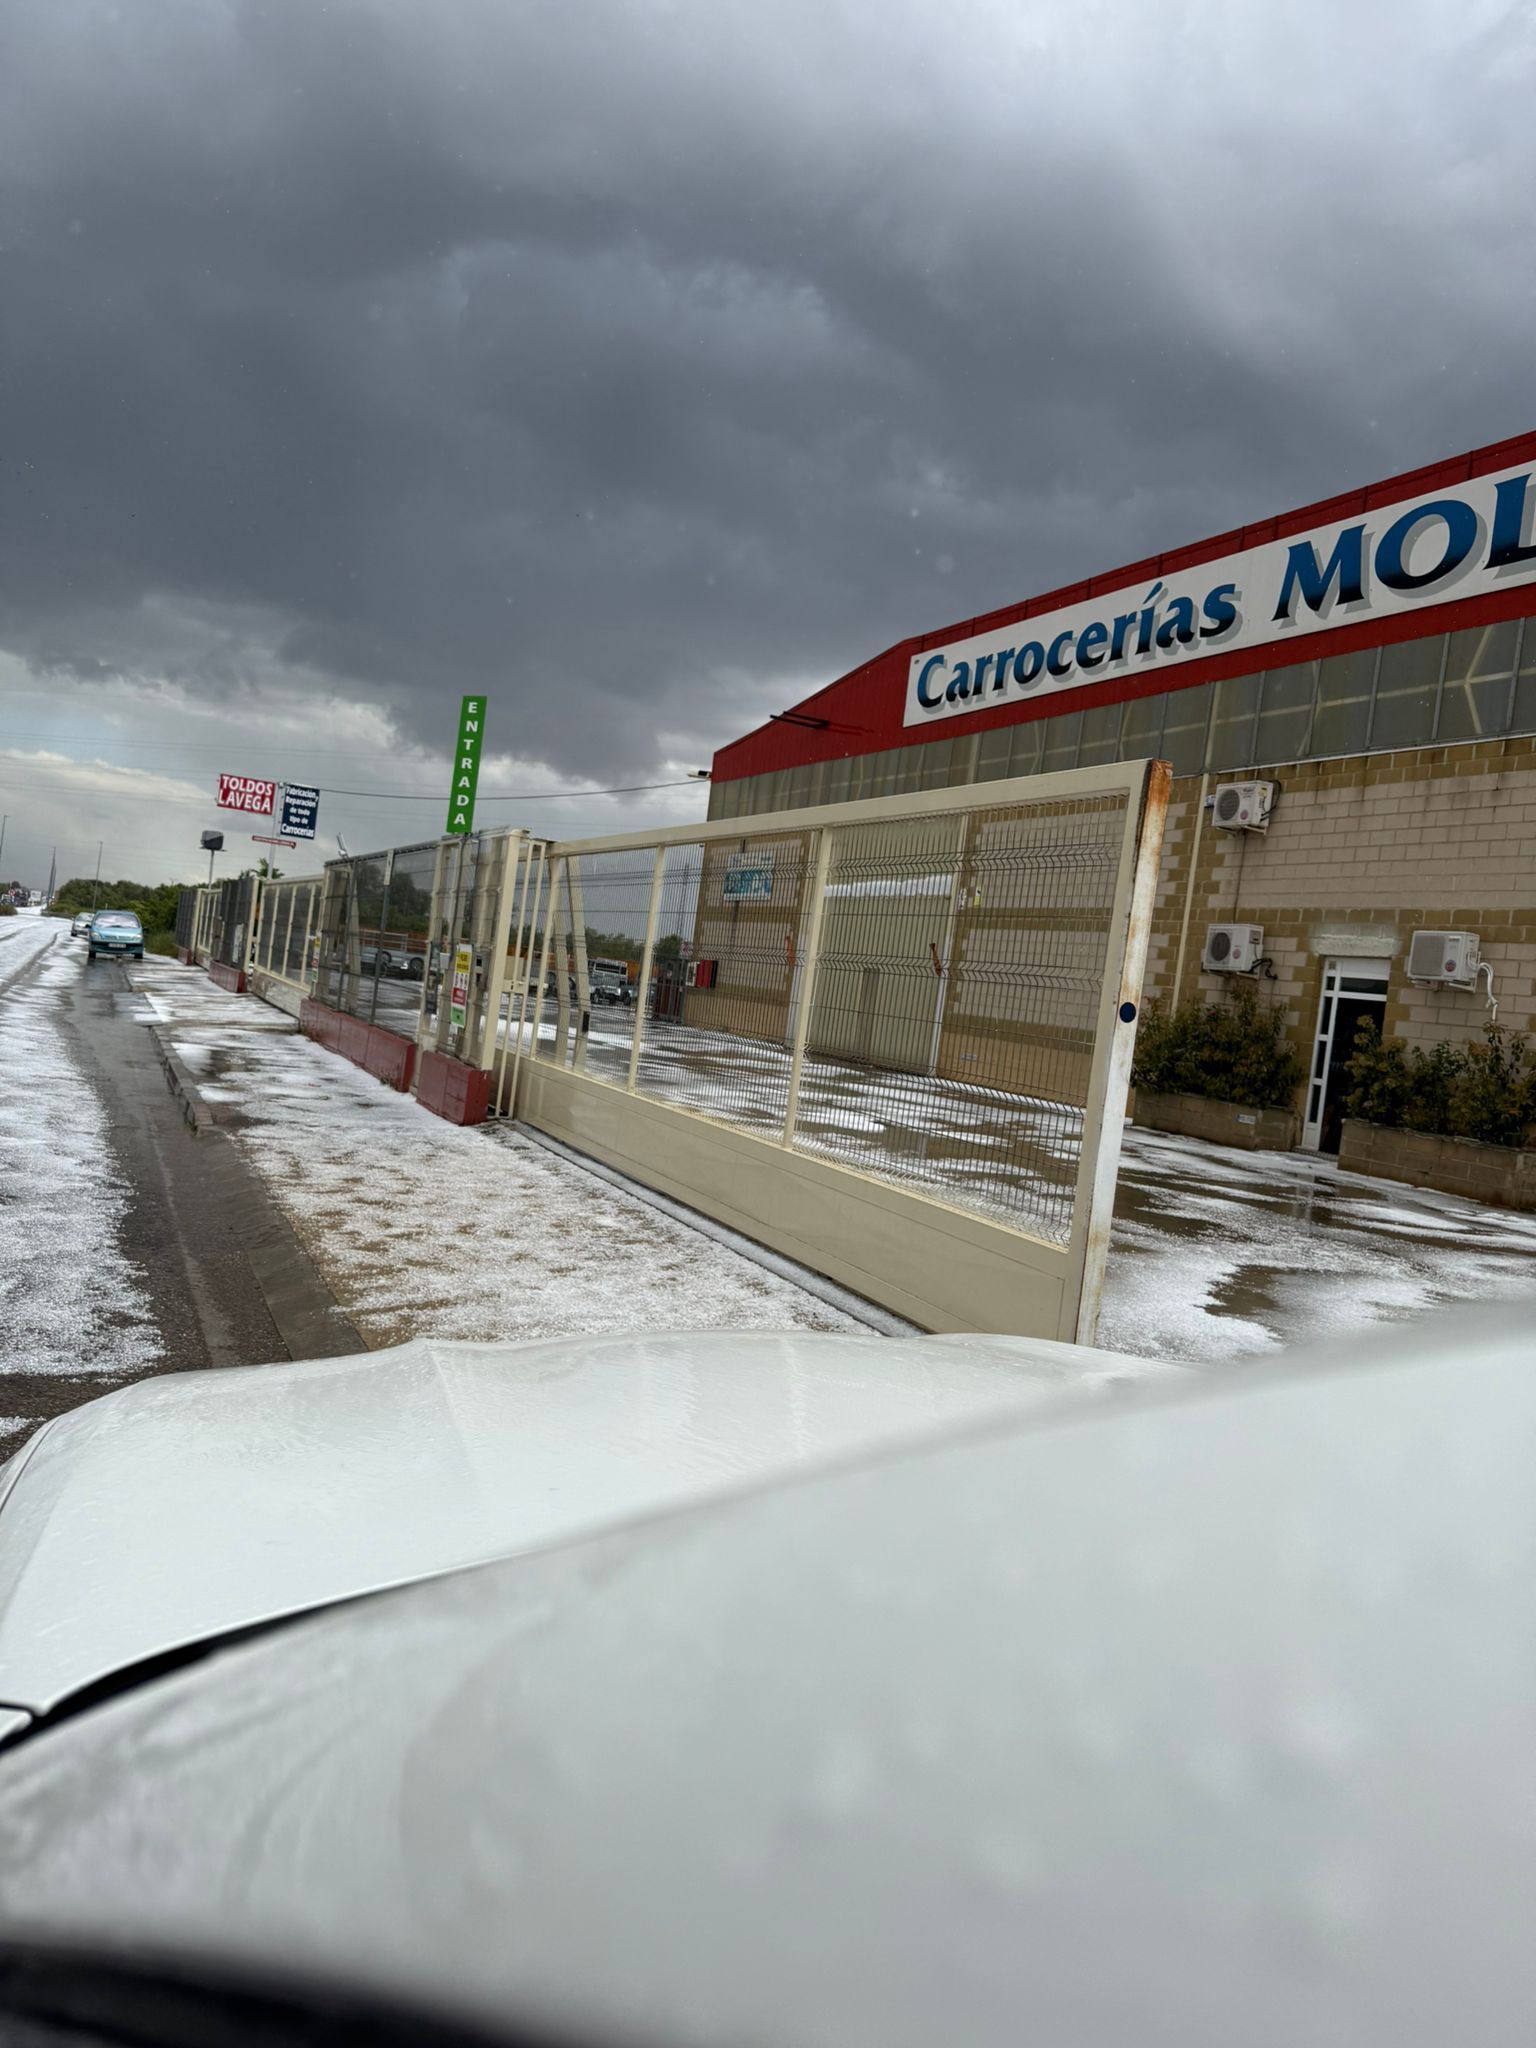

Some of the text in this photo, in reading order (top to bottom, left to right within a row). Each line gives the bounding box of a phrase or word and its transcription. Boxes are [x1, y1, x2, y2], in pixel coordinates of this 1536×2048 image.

[915, 472, 1536, 710] Carrocerías MOL
[453, 701, 478, 825] ENTRADA
[222, 776, 273, 795] TOLDOS
[286, 786, 316, 797] Fabricación
[286, 797, 316, 808] Reparación
[290, 816, 301, 824] tipo
[282, 824, 314, 837] Carrocerías
